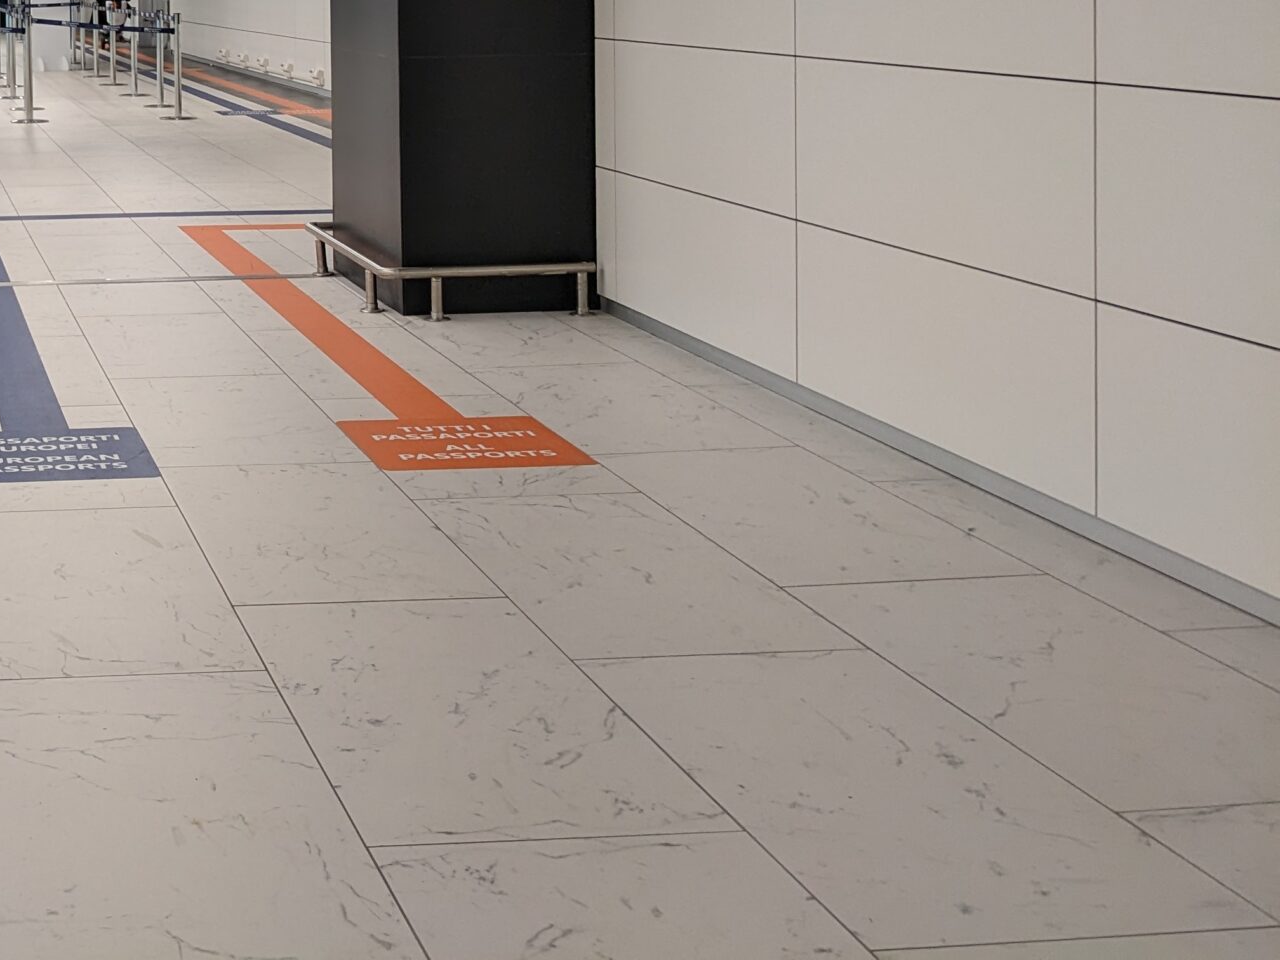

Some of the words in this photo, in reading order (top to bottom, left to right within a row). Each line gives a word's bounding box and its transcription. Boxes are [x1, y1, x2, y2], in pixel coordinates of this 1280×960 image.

[395, 424, 476, 433] TUTTI
[372, 430, 537, 441] PASSAPORTI
[445, 443, 495, 451] ALL
[398, 449, 558, 461] PASSPORTS
